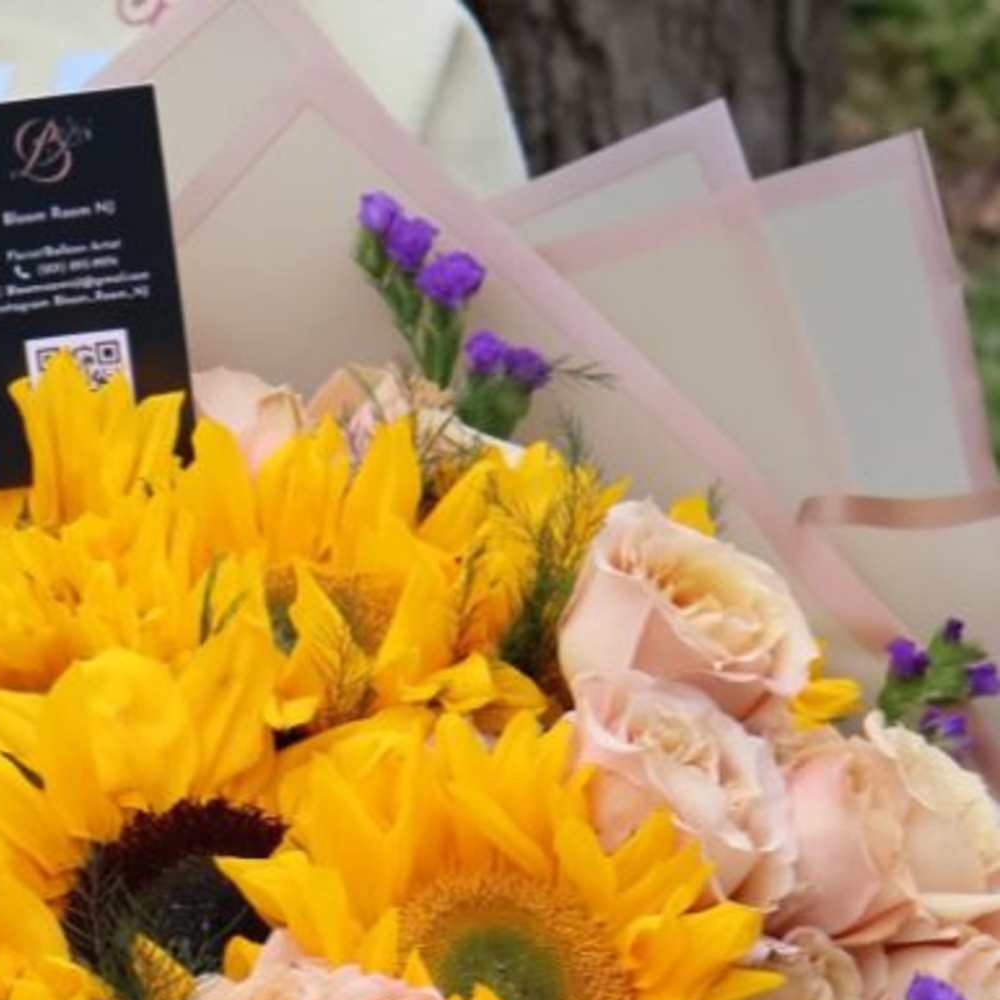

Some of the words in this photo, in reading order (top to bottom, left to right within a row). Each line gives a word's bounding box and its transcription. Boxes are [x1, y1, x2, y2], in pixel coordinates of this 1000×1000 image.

[2, 210, 47, 227] Bloom
[50, 204, 92, 219] Room
[94, 199, 117, 215] NJ
